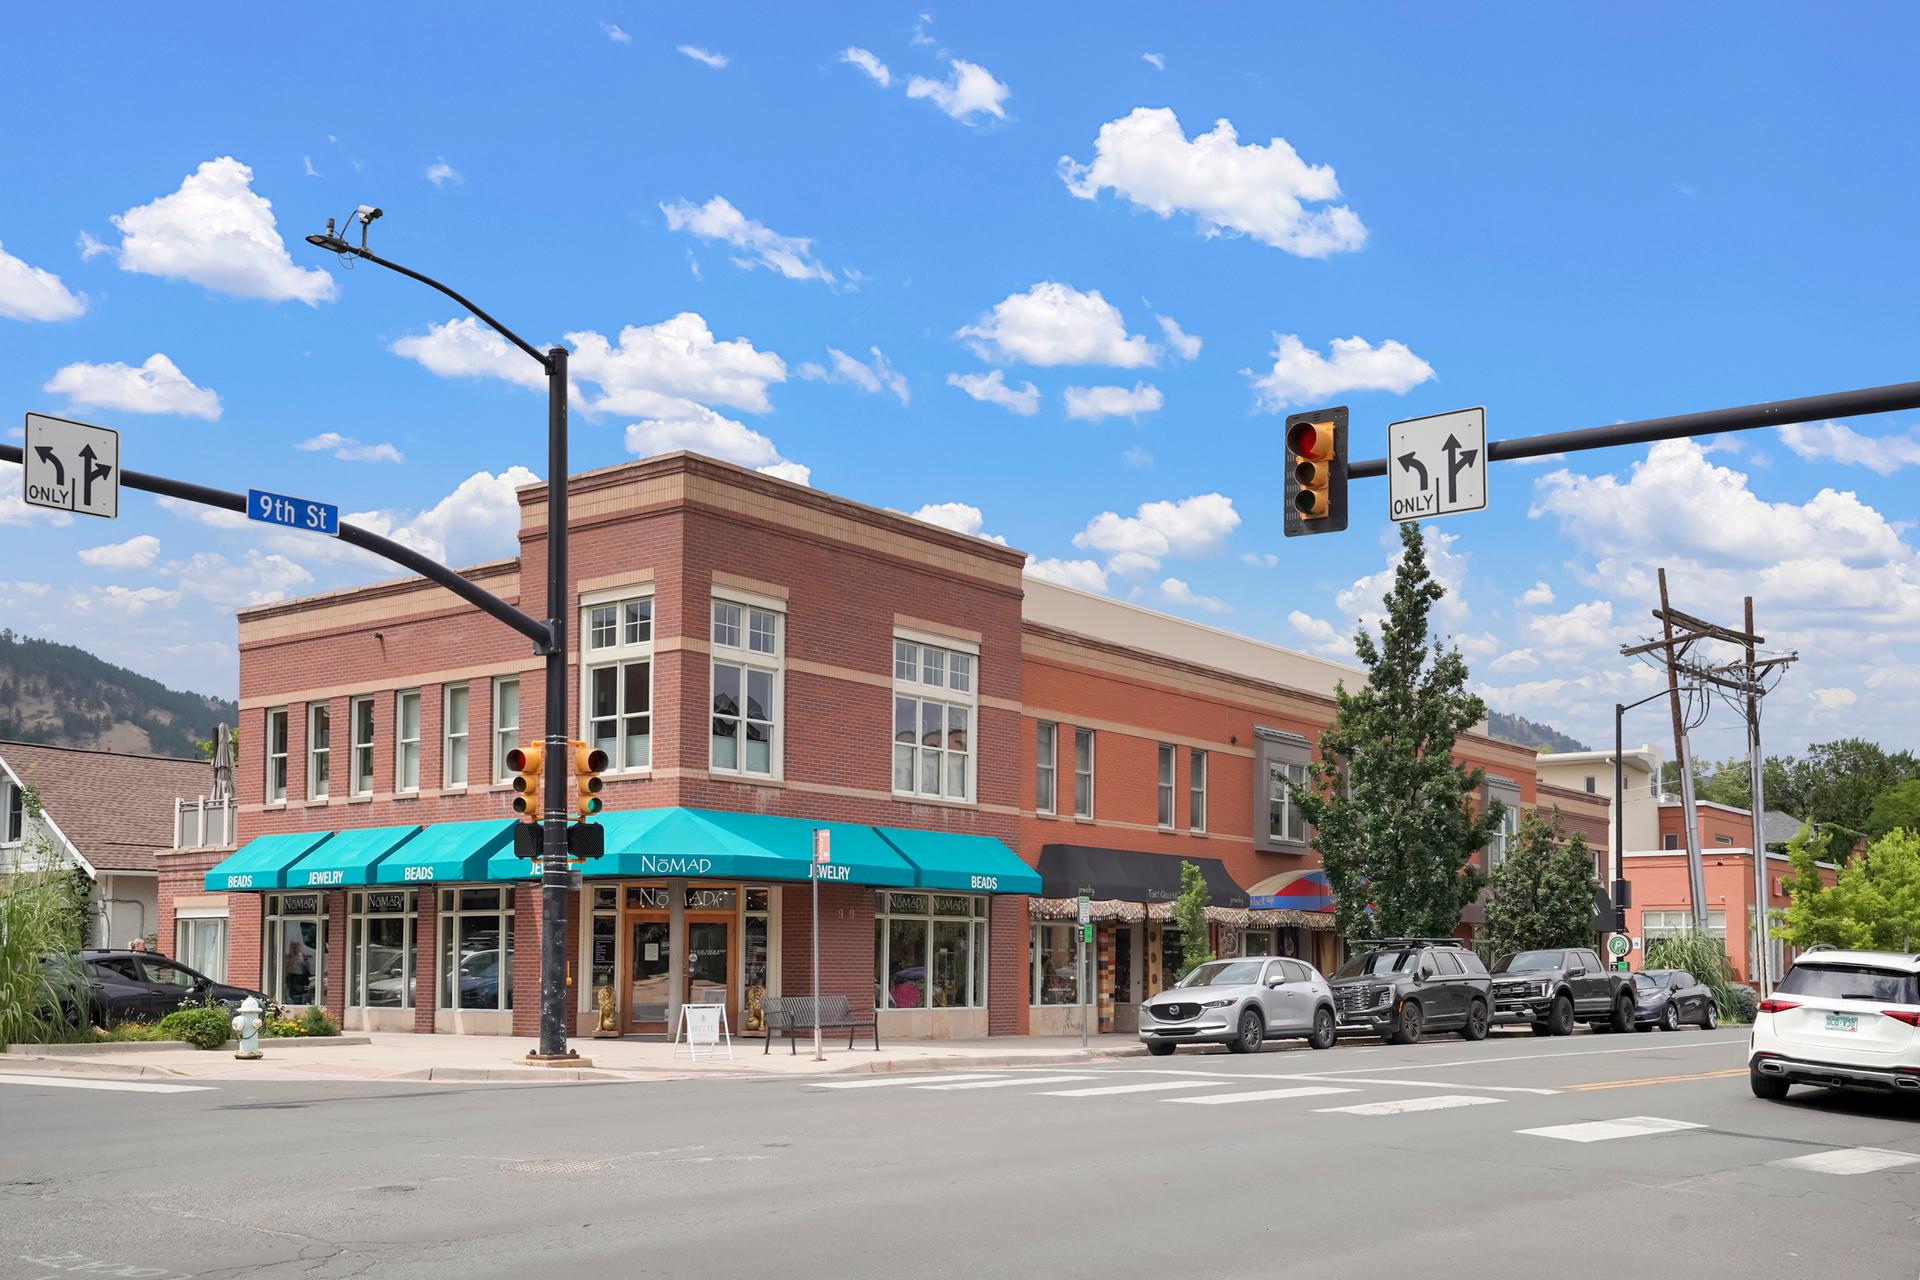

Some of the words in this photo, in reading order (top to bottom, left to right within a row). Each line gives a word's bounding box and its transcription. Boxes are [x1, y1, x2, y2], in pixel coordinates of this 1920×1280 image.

[28, 485, 68, 504] ONLY
[1394, 494, 1433, 514] ONLY
[260, 495, 296, 524] 9th
[306, 507, 328, 529] St
[308, 870, 343, 884] JEWELRY
[404, 866, 433, 880] BEADS
[228, 875, 252, 888] BEADS
[971, 875, 997, 889] BEADS
